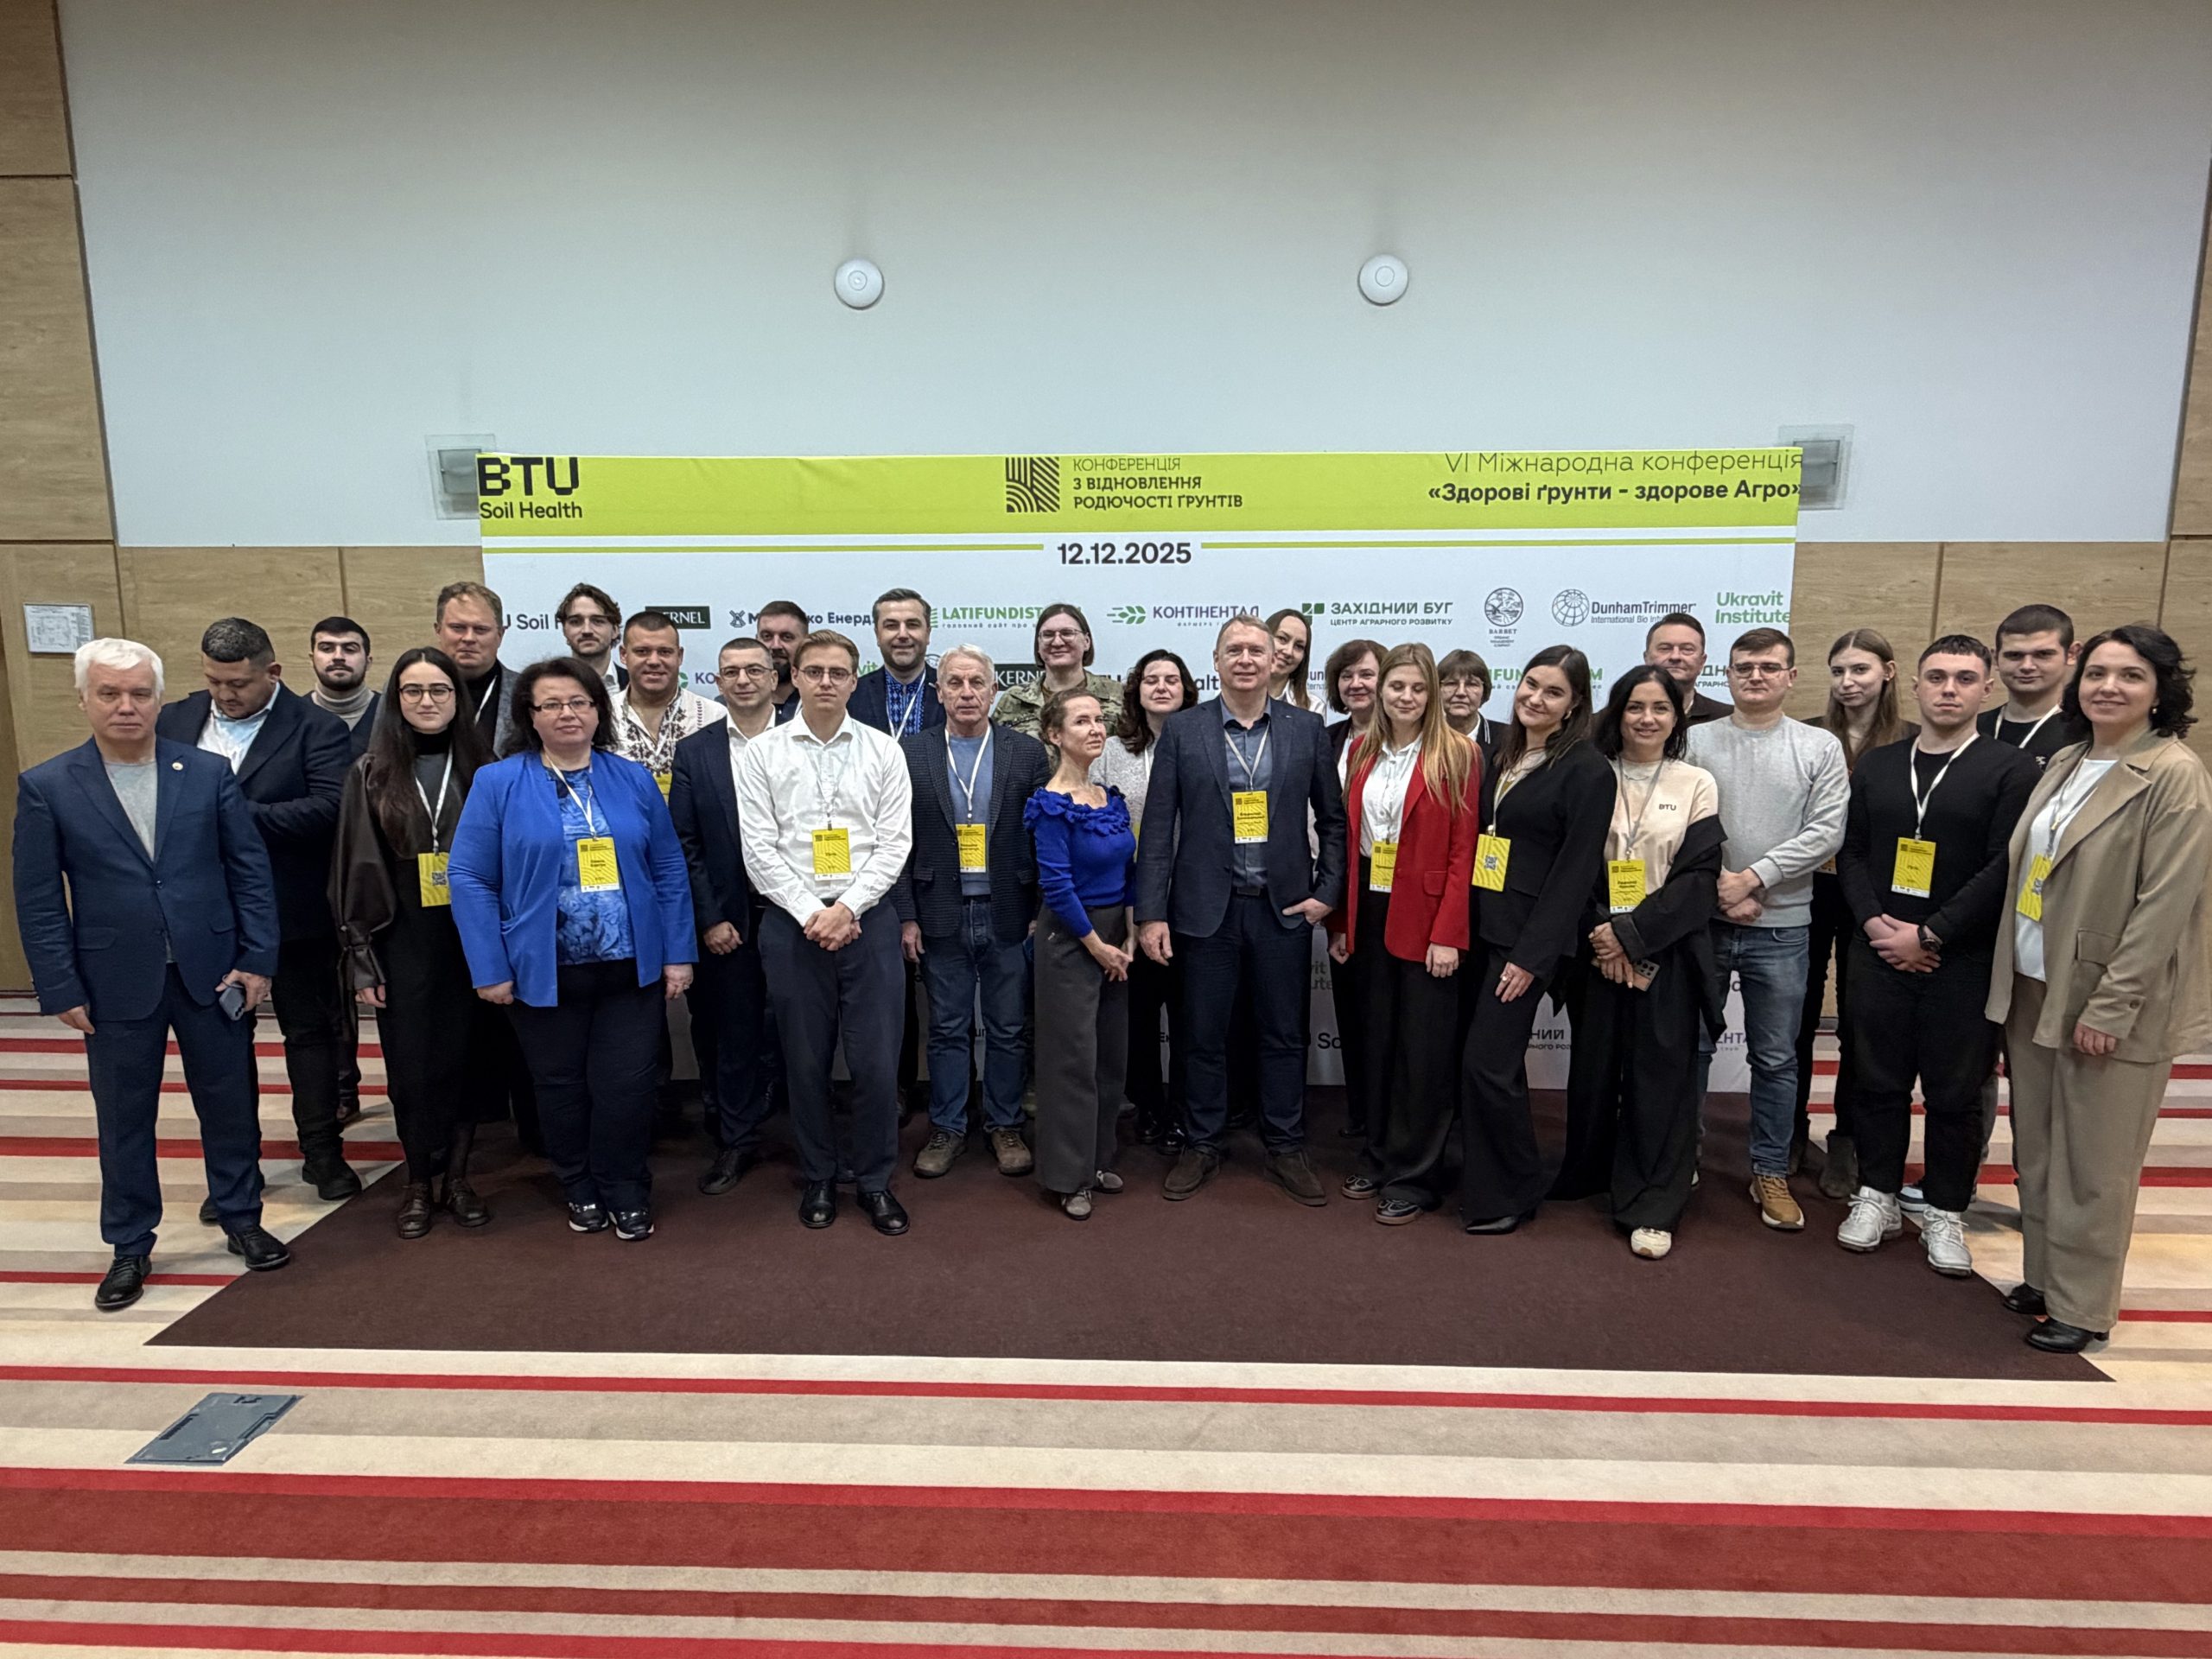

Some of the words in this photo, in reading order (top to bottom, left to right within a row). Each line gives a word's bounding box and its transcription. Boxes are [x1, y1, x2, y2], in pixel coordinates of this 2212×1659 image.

[1073, 457, 1181, 472] КОНФЕРЕНЦІЯ
[1445, 453, 1469, 473] VI
[1478, 452, 1634, 477] Міжнародна
[1642, 448, 1802, 475] конференція
[477, 456, 580, 496] BTU
[1087, 476, 1202, 492] ВІДНОВЛЕННЯ
[1428, 482, 1531, 505] «Здорові
[1537, 483, 1612, 505] ґрунти
[1635, 484, 1729, 504] здорове
[1734, 480, 1802, 502] Агро»
[480, 501, 514, 519] Soil
[519, 501, 583, 518] Health
[1074, 495, 1173, 511] РОДЮЧОСТІ
[1178, 493, 1243, 509] ҐРУНТІВ
[1058, 542, 1192, 565] 12.12.2025
[1717, 589, 1783, 607] Ukravit
[942, 607, 1043, 620] LATIFUNDIST
[1331, 601, 1418, 614] ЗАХІДНИЙ
[1424, 602, 1453, 614] БУГ
[1592, 601, 1694, 614] DunhamTrimmer
[1715, 607, 1790, 624] Institute
[517, 613, 550, 630] Soil
[664, 612, 706, 624] RNEL
[828, 612, 874, 627] Енерд
[995, 671, 1046, 687] KERN
